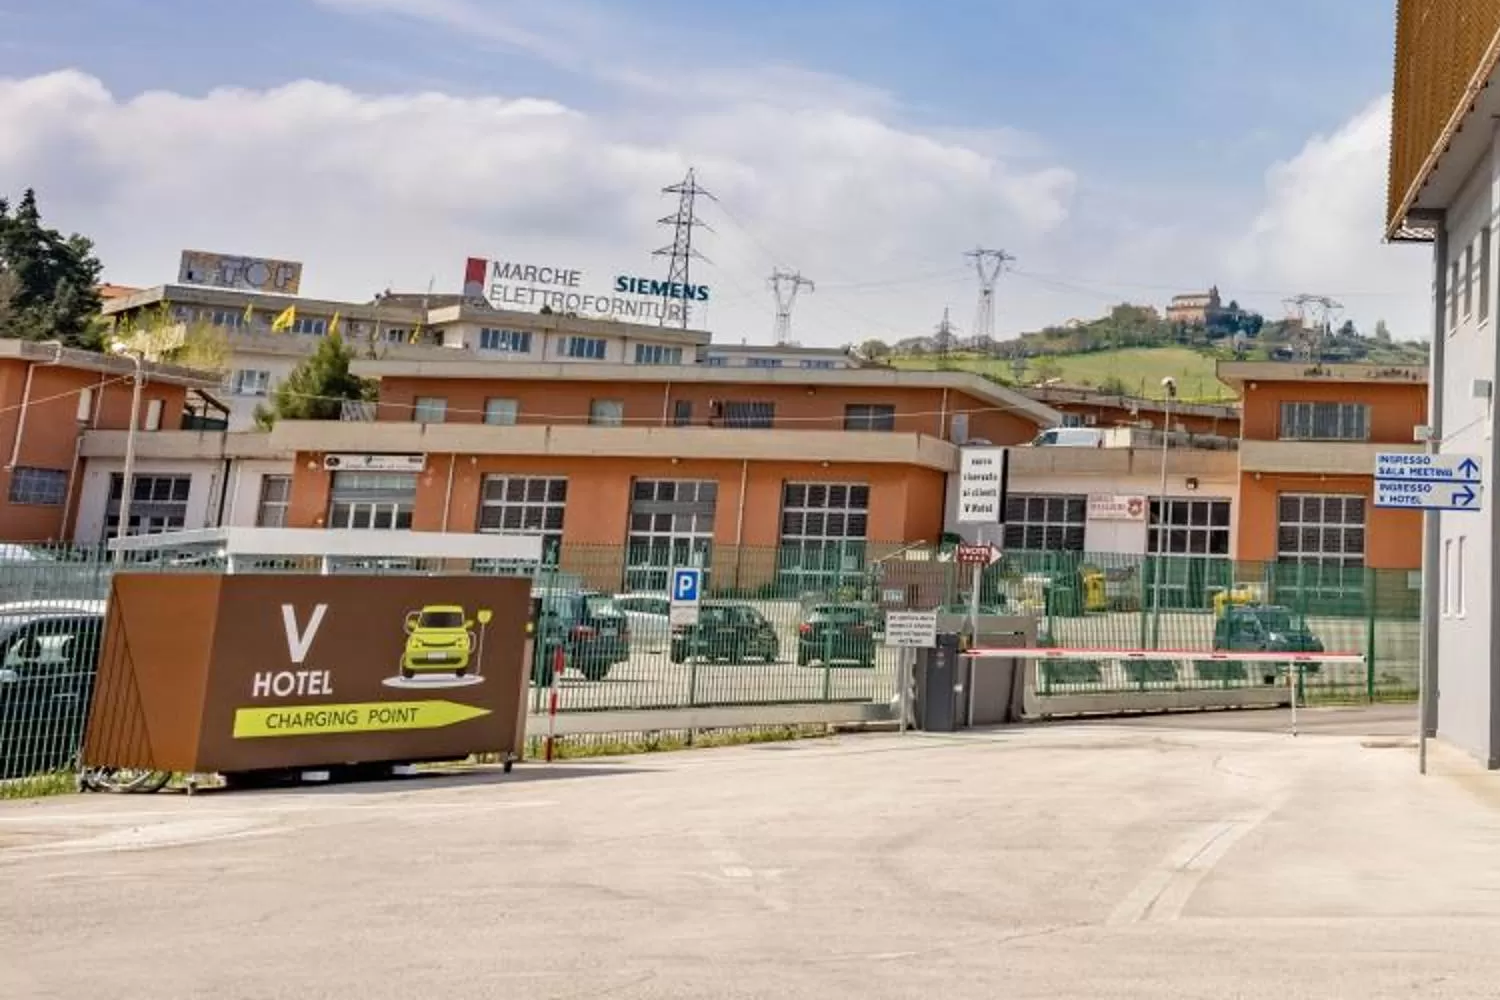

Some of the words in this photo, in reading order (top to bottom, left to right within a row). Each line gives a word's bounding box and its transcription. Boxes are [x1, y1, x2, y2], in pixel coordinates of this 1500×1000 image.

[491, 260, 583, 288] MARCHE
[614, 275, 709, 300] SIEMENS
[489, 283, 693, 323] ELETTROFORNITURE
[679, 575, 693, 598] P
[280, 604, 328, 663] V
[252, 670, 334, 698] HOTEL
[265, 711, 359, 730] CHARGING
[367, 707, 420, 725] POINT
